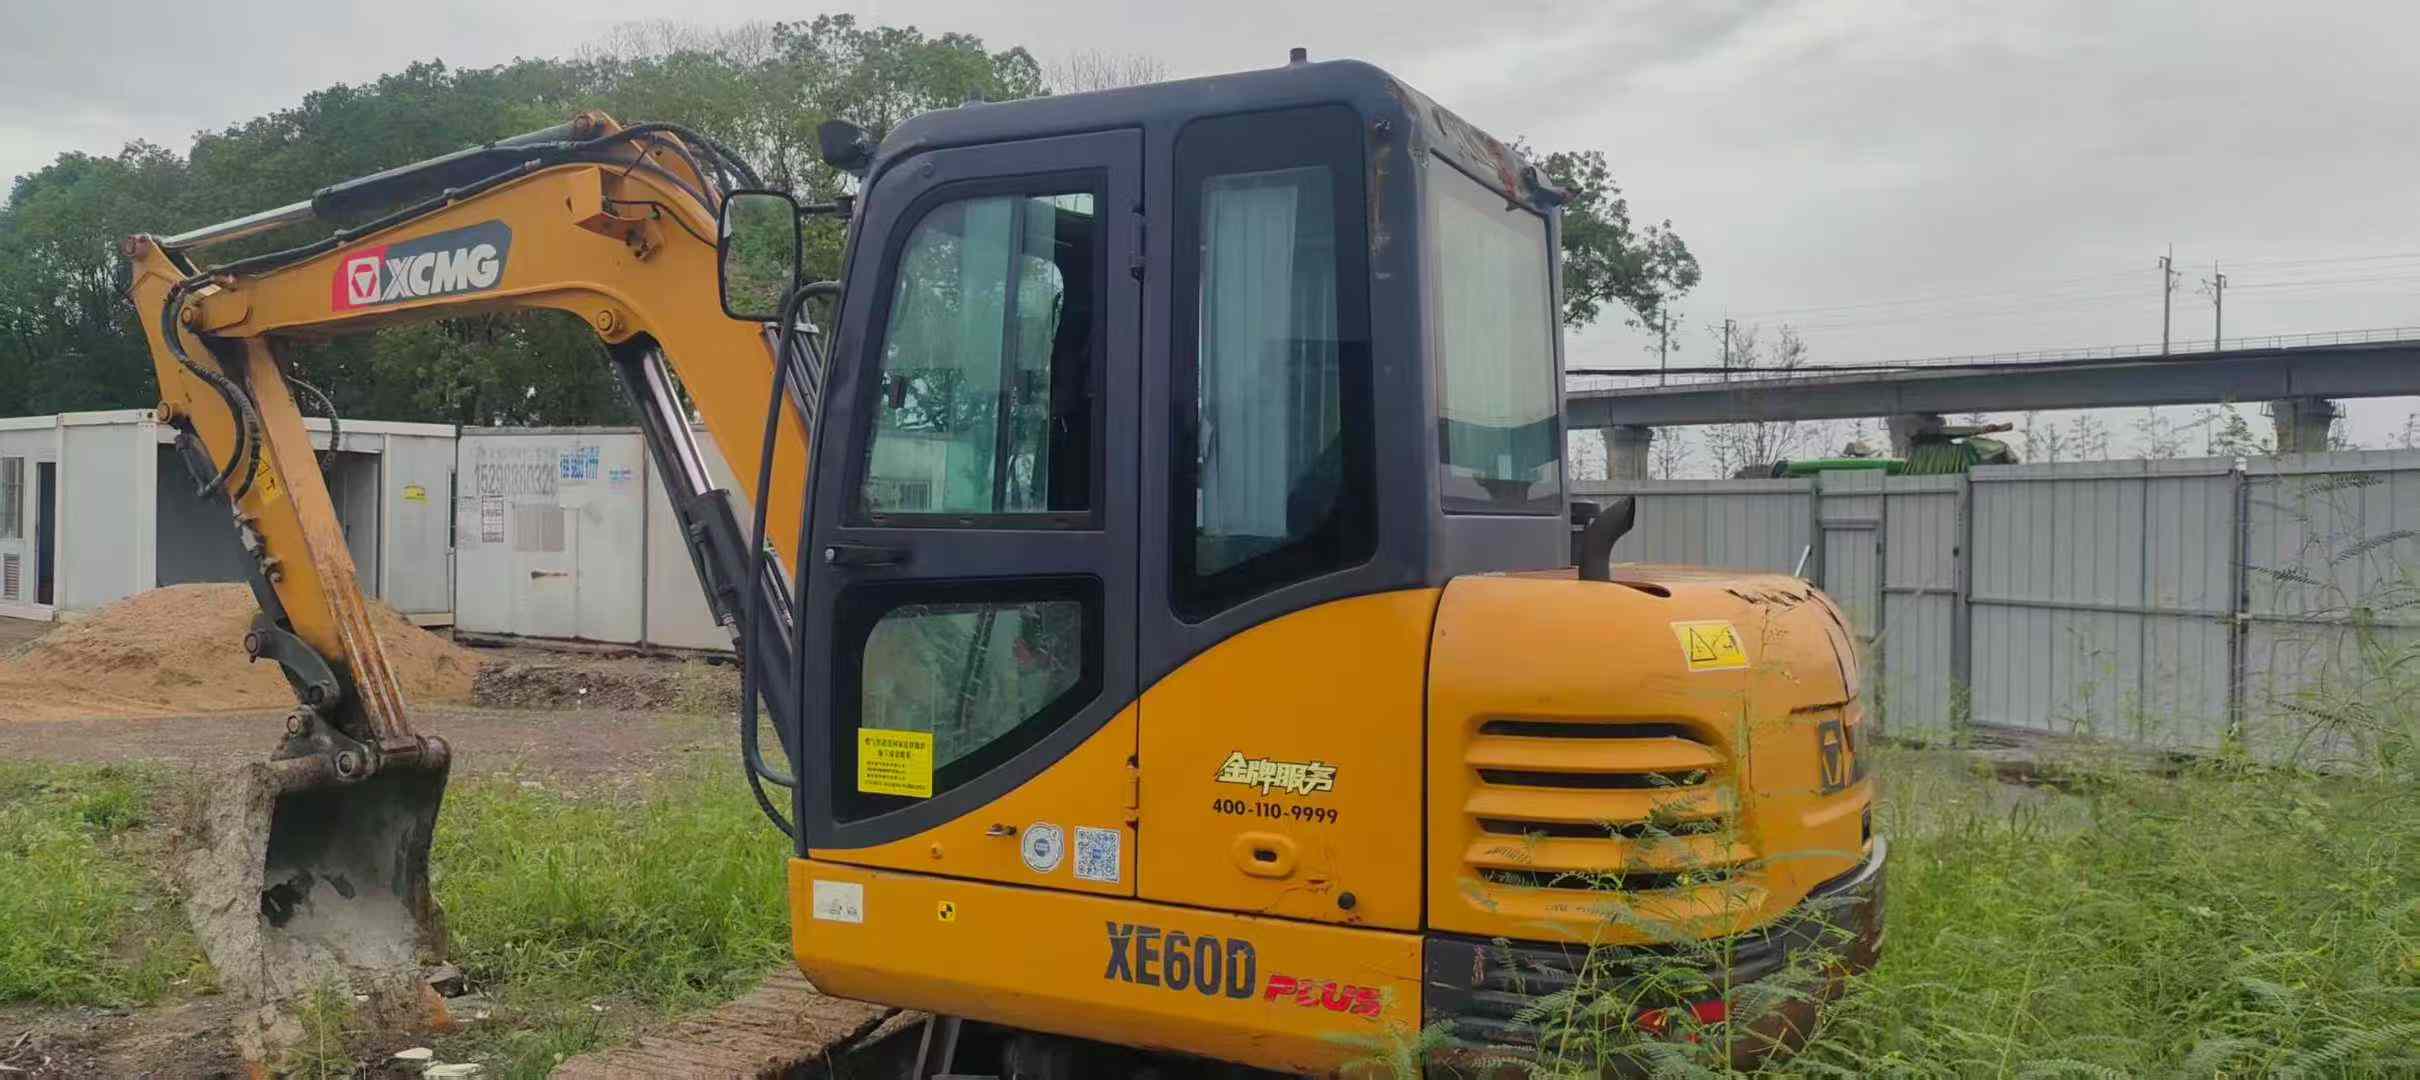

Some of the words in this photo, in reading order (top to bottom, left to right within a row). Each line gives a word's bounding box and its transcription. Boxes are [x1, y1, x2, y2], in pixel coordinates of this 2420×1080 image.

[381, 243, 499, 301] XCMG
[1216, 751, 1337, 796] 金牌服务
[1213, 798, 1338, 824] 400-110-9999
[1104, 921, 1256, 999] XE60D
[1264, 974, 1383, 1021] PLUS
